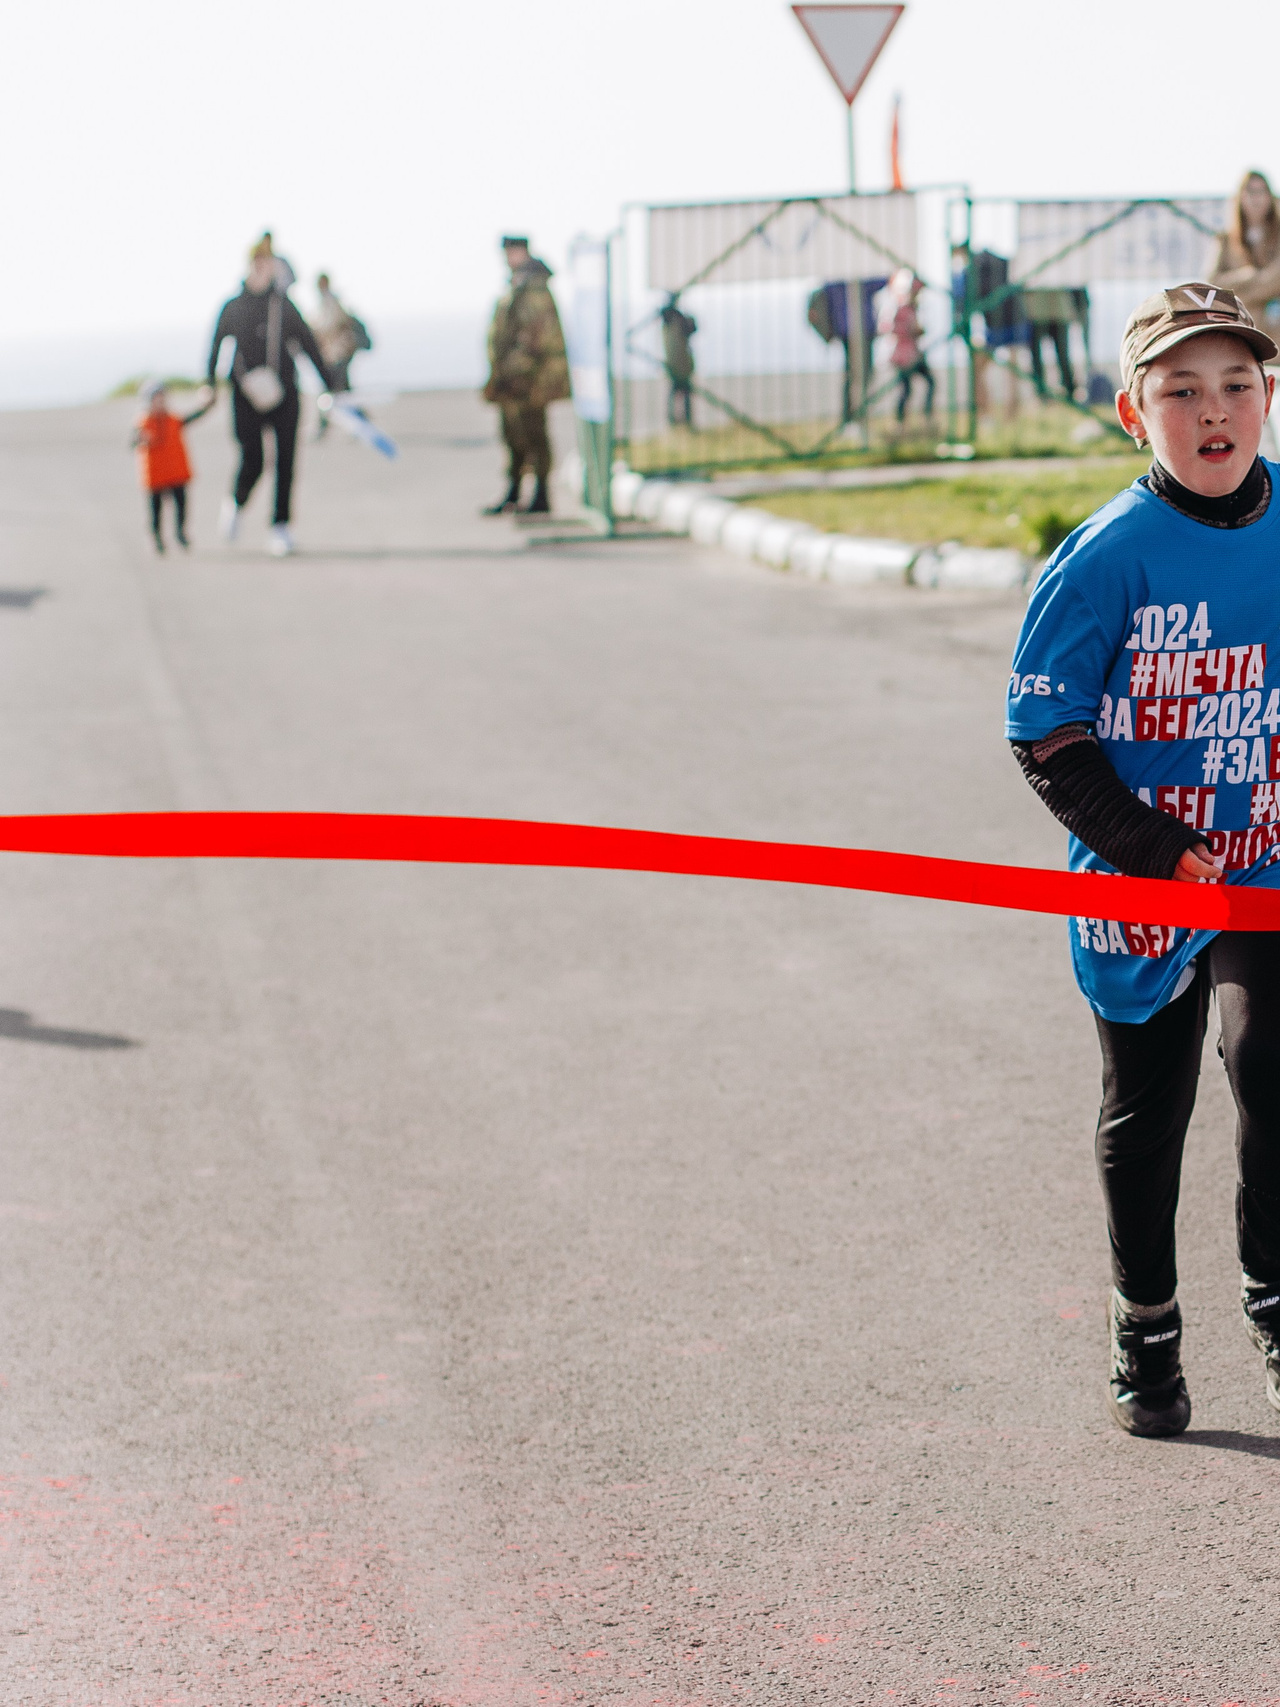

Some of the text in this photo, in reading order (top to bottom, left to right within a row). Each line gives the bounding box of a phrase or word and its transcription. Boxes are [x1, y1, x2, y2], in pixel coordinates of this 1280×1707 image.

[1182, 289, 1217, 309] V
[1125, 601, 1212, 651] 2024
[1129, 643, 1267, 697] #МЕЧТА
[1131, 786, 1216, 830] АБЕГ
